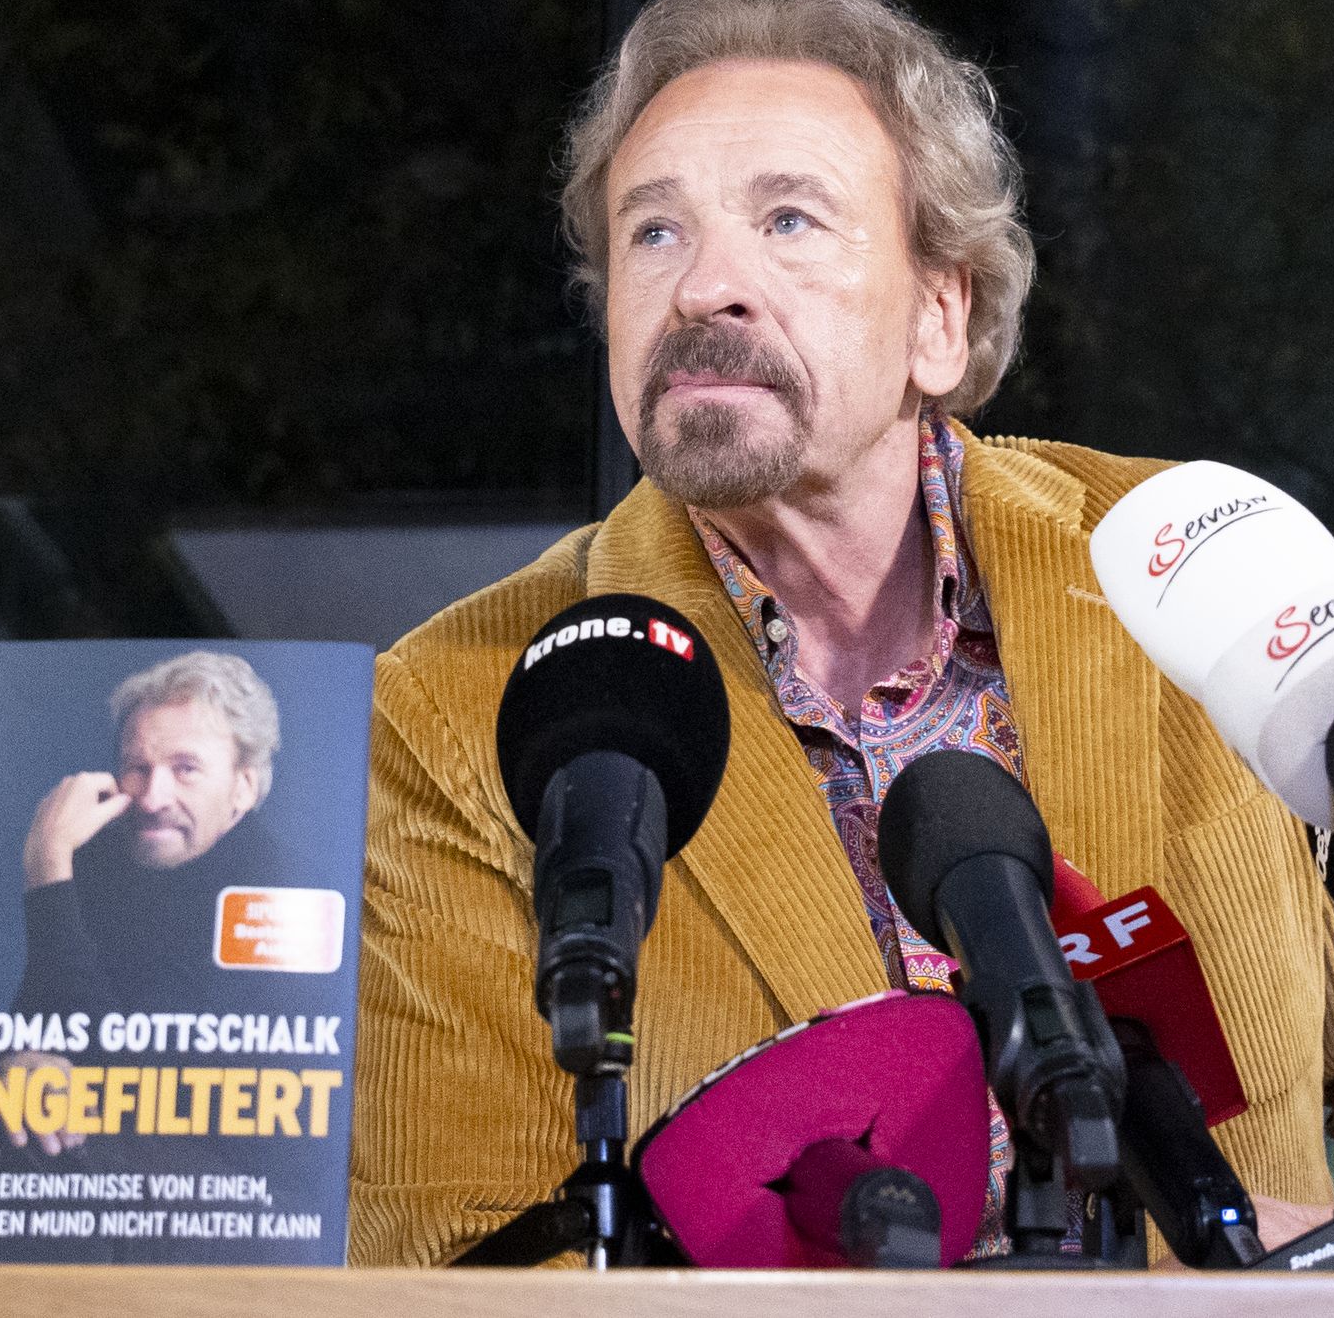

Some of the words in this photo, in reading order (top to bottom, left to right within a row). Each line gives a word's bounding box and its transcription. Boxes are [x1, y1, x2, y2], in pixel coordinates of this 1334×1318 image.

[99, 1011, 341, 1055] GOTTSCHALK
[149, 1174, 195, 1200] VON
[200, 1174, 273, 1207] EINEM,
[30, 1210, 96, 1238] MUND
[101, 1210, 167, 1238] NICHT
[170, 1212, 254, 1239] HALTEN
[258, 1213, 322, 1239] KANN
